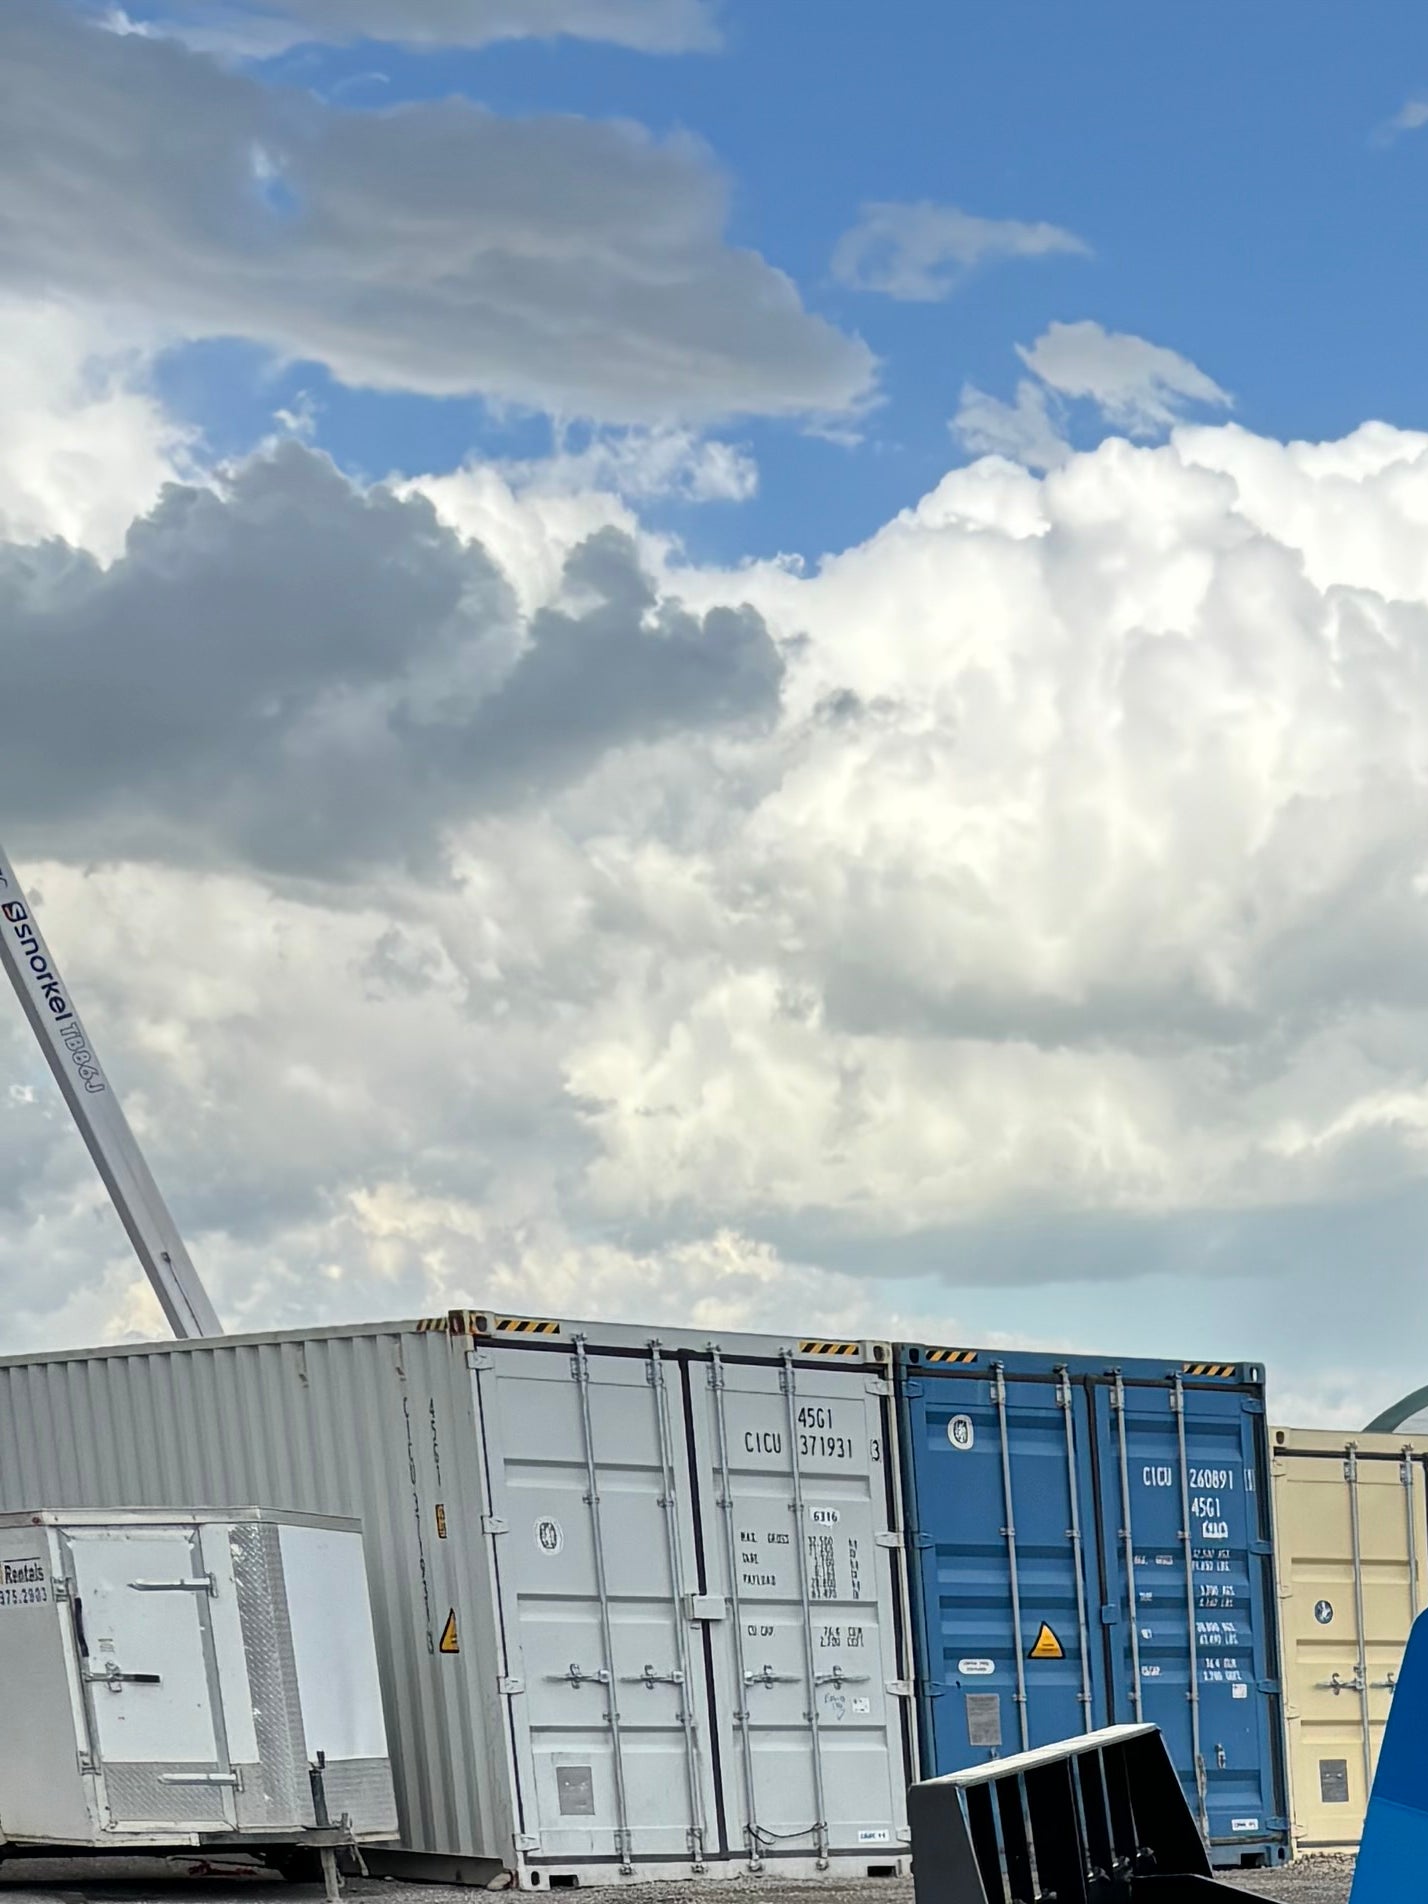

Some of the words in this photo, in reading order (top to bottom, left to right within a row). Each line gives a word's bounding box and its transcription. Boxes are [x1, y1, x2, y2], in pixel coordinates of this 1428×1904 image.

[14, 922, 72, 1022] snorkel
[798, 1407, 832, 1429] 45G1
[744, 1431, 782, 1454] CICU
[800, 1434, 852, 1459] 371931
[1142, 1466, 1173, 1487] CICU
[1189, 1468, 1234, 1490] 260891
[1191, 1497, 1221, 1518] 45G1
[4, 1562, 44, 1585] Rentals
